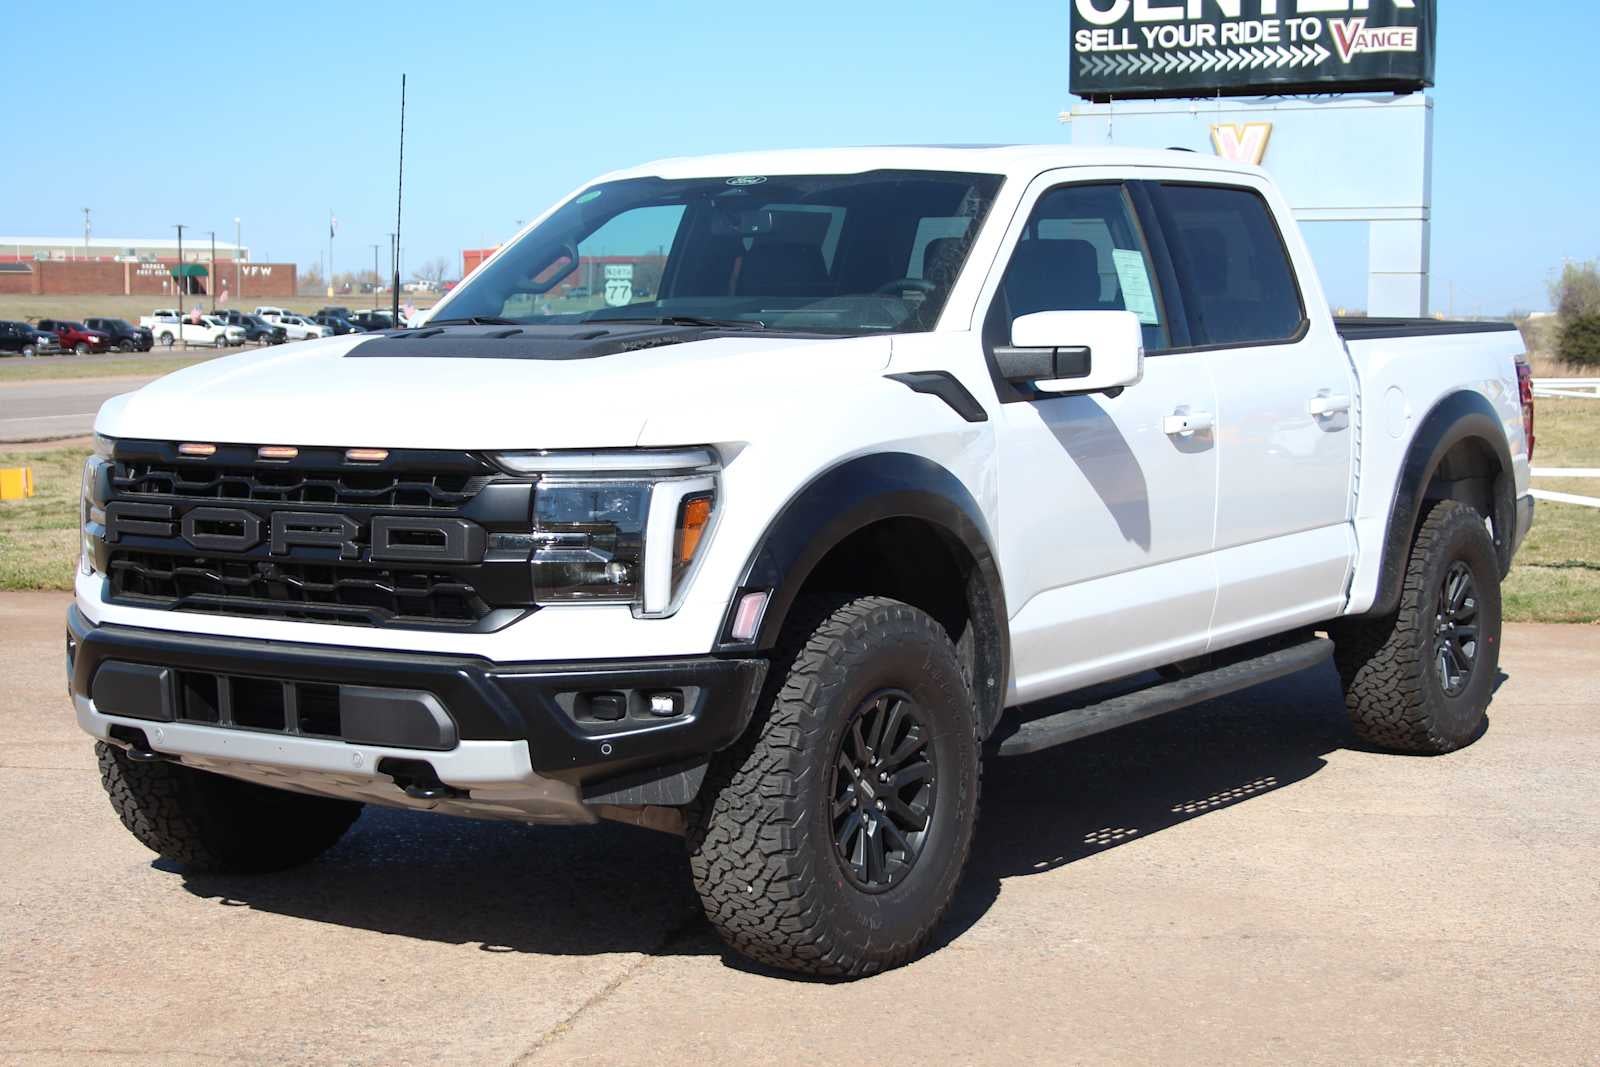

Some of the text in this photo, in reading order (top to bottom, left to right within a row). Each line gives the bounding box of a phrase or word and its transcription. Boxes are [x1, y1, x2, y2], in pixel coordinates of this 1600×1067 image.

[1075, 17, 1413, 63] SELL YOUR RIDE TO VANCE
[242, 265, 272, 276] VFW
[607, 285, 629, 300] 77
[104, 499, 488, 566] FORD
